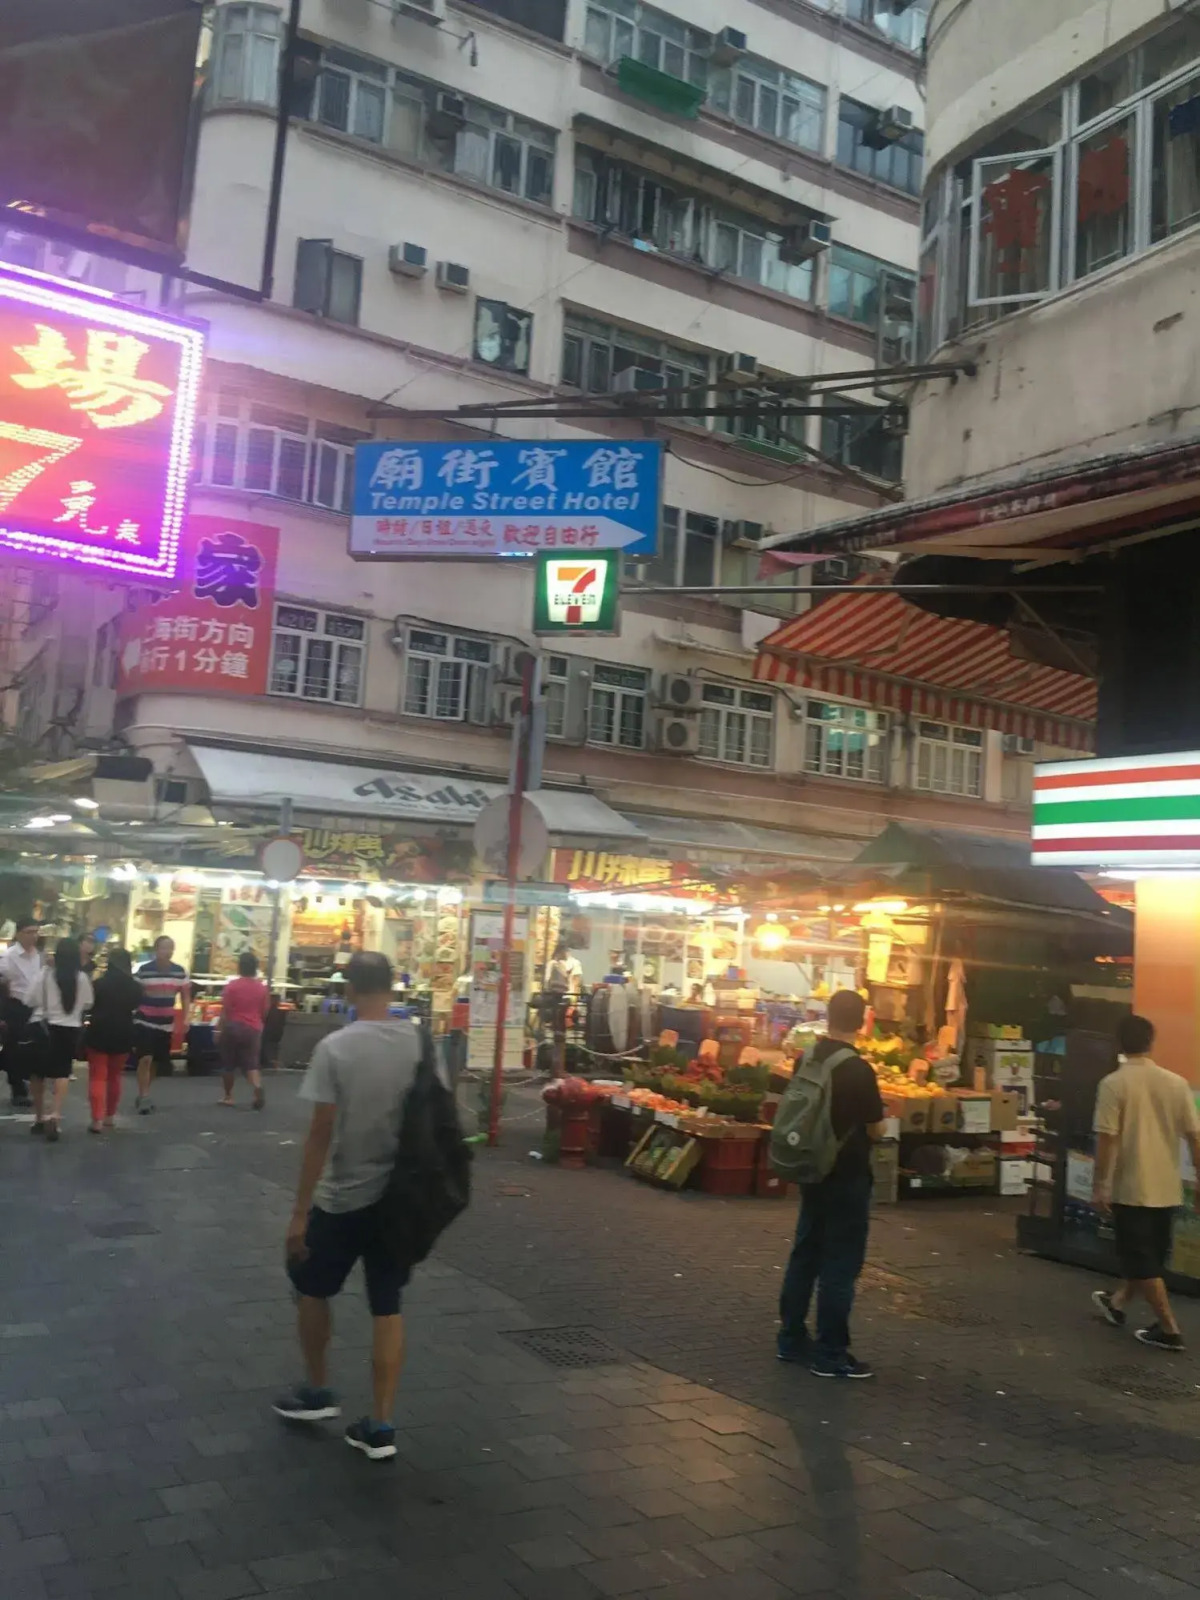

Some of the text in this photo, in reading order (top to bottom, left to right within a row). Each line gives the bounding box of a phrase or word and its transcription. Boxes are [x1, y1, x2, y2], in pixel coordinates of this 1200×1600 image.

[10, 323, 175, 429] 場
[369, 447, 644, 491] 廟街賓館
[371, 491, 641, 514] Temple Street Hotel
[557, 567, 597, 623] 7
